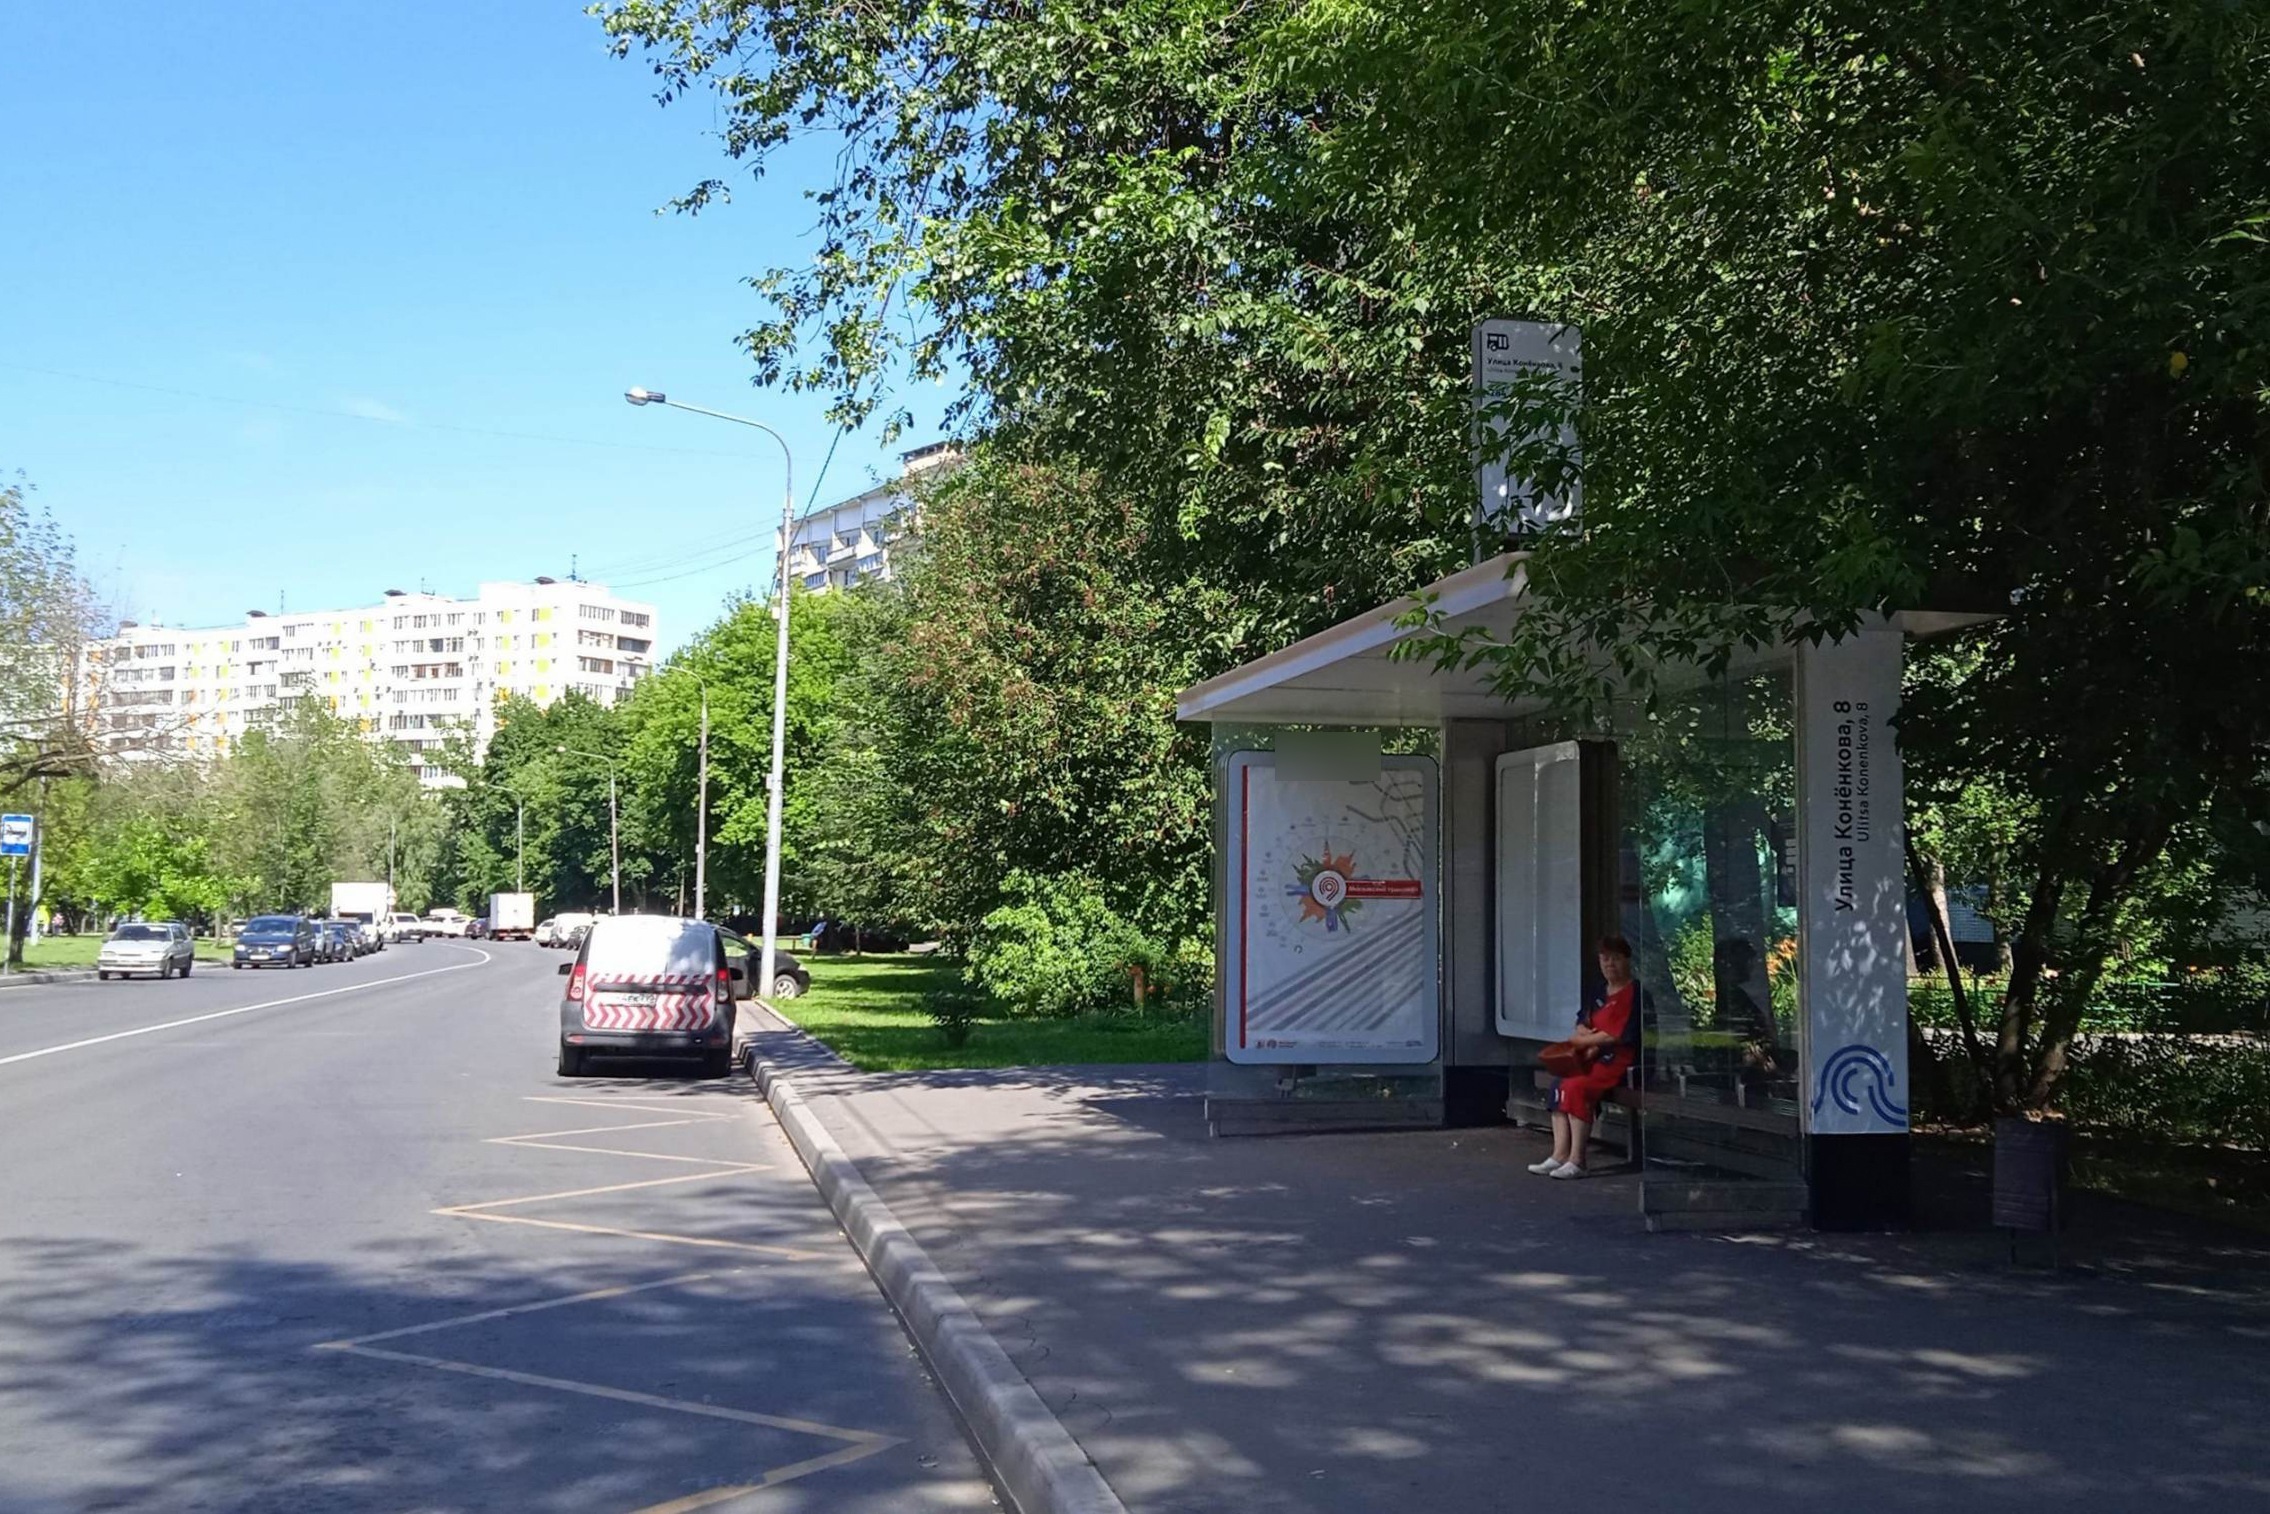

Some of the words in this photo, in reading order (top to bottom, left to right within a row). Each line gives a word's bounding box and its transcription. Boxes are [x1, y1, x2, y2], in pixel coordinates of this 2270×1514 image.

[1833, 700, 1851, 713] 8
[1856, 702, 1868, 711] 8
[1834, 719, 1855, 839] Конёнкова,
[1856, 715, 1870, 796] Konenkova,
[1856, 800, 1869, 842] Ulitsa
[1835, 846, 1856, 911] Улица
